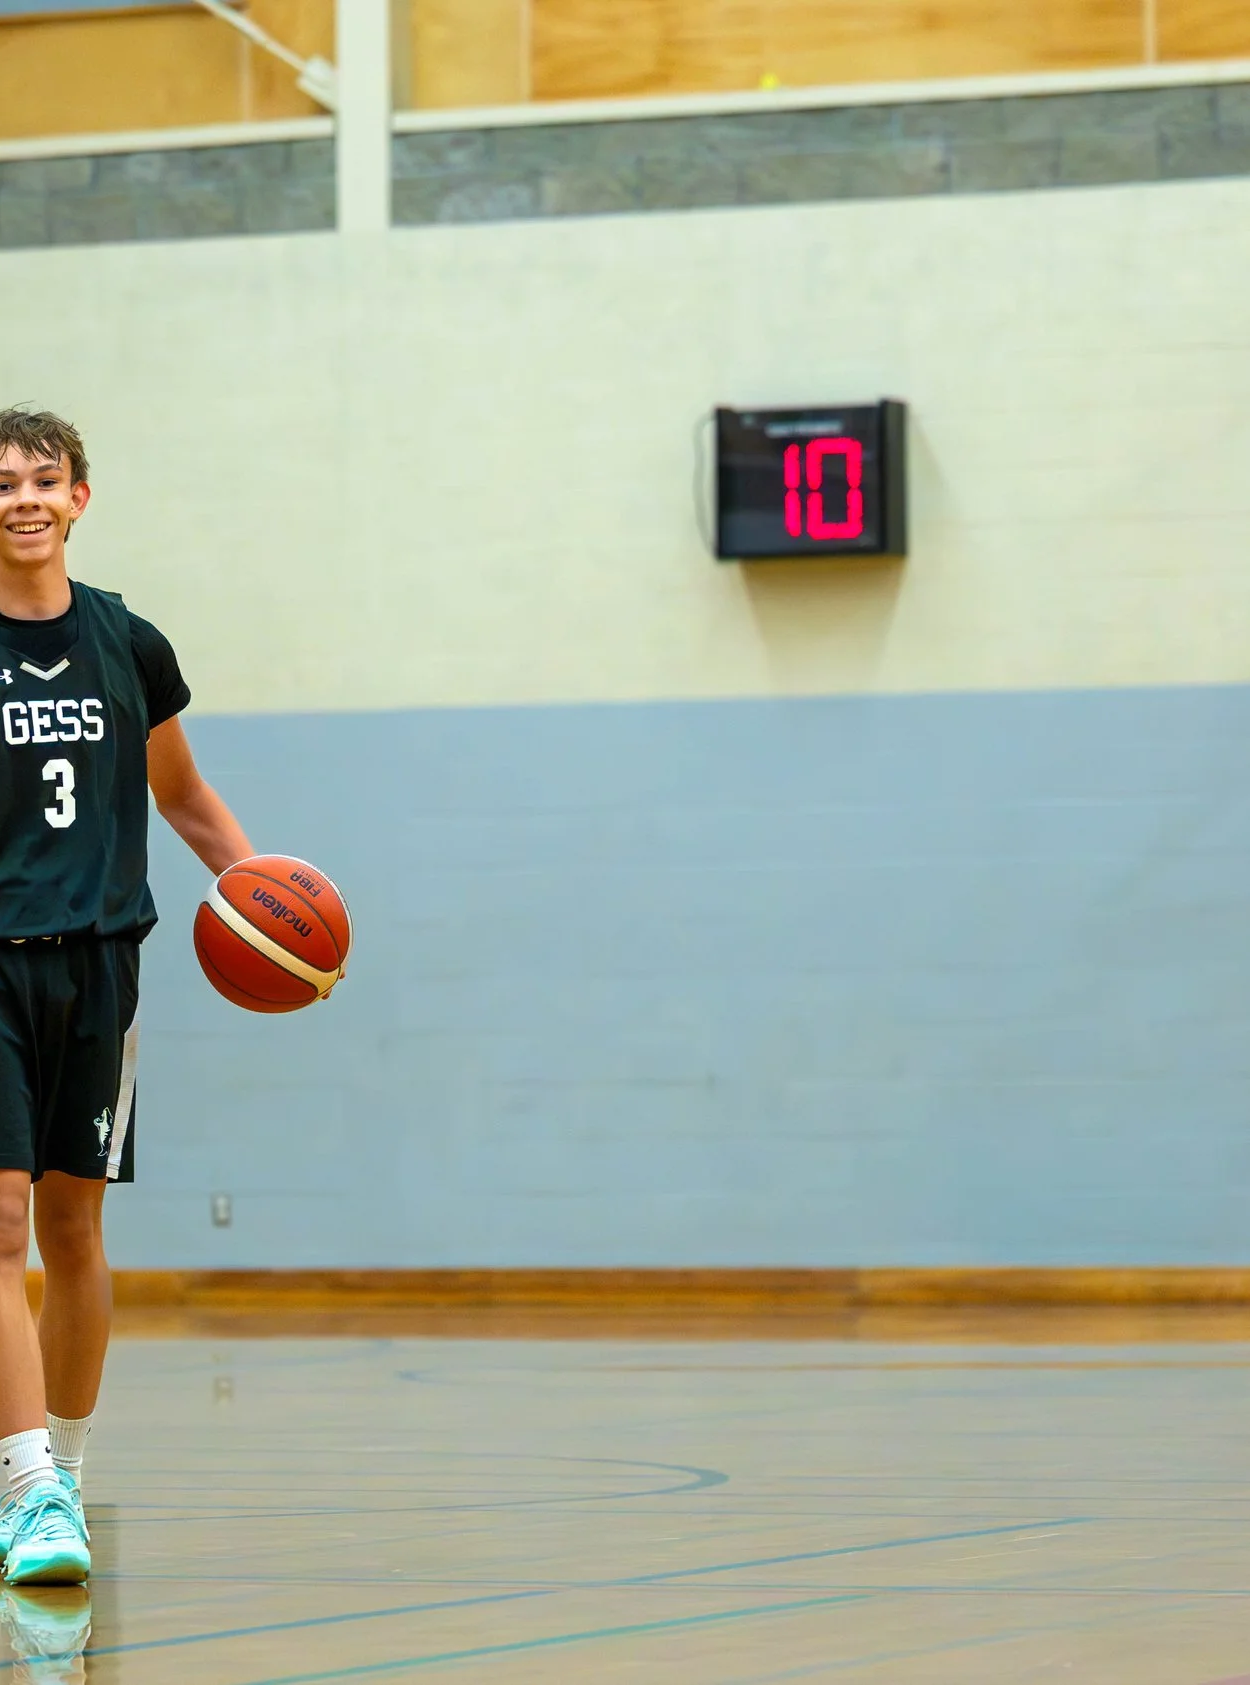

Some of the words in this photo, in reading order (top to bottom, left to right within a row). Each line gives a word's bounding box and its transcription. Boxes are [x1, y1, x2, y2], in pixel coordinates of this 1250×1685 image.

[783, 437, 863, 541] 10
[2, 698, 104, 745] GESS
[41, 758, 76, 829] 3
[290, 871, 322, 898] FIBA
[252, 887, 314, 938] molten
